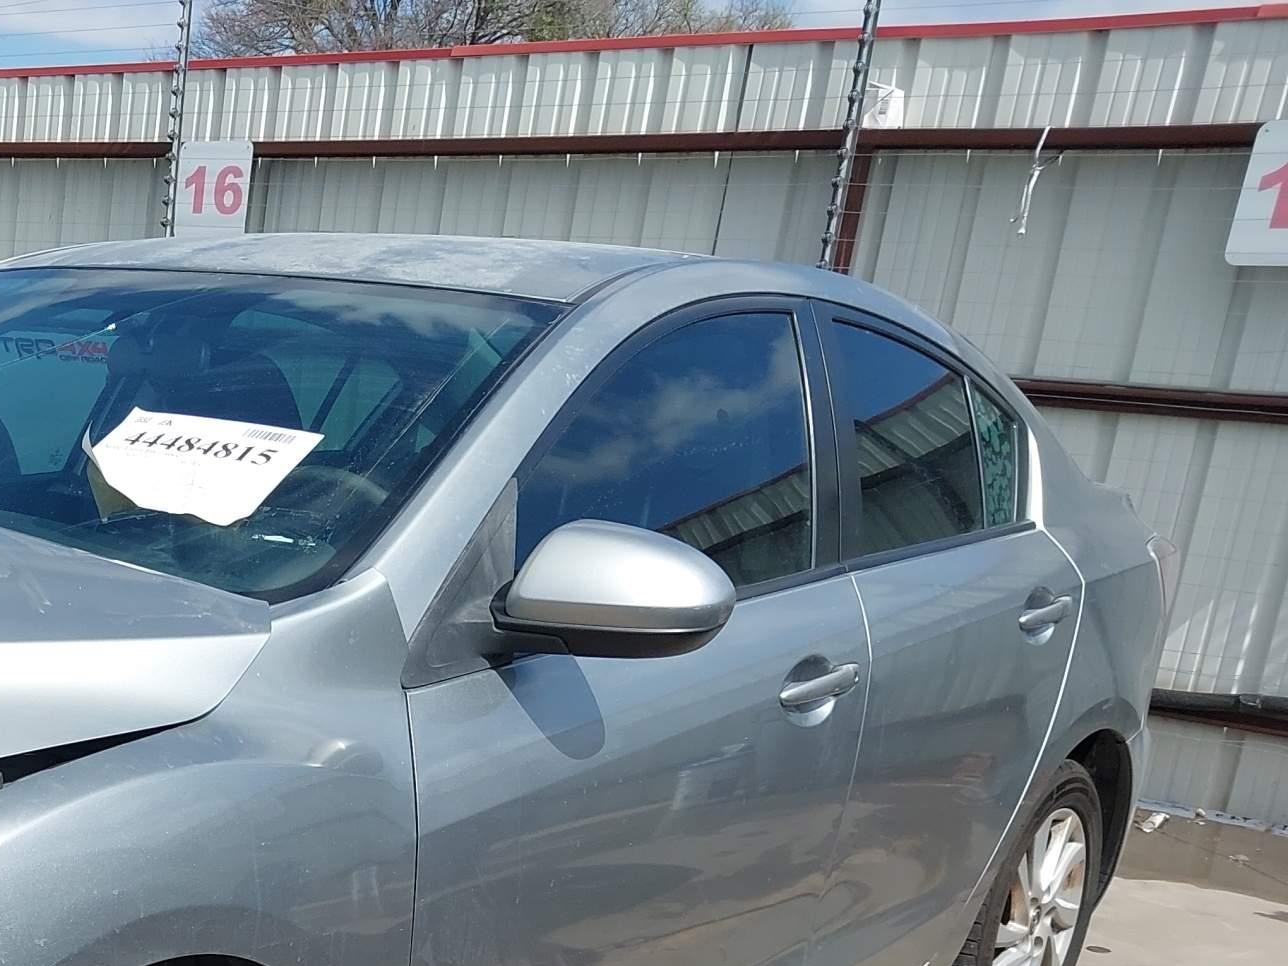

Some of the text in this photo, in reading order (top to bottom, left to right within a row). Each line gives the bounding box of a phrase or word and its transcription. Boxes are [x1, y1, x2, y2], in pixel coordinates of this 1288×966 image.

[185, 166, 244, 214] 16
[0, 336, 56, 360] TRD
[123, 431, 279, 465] 44484815
